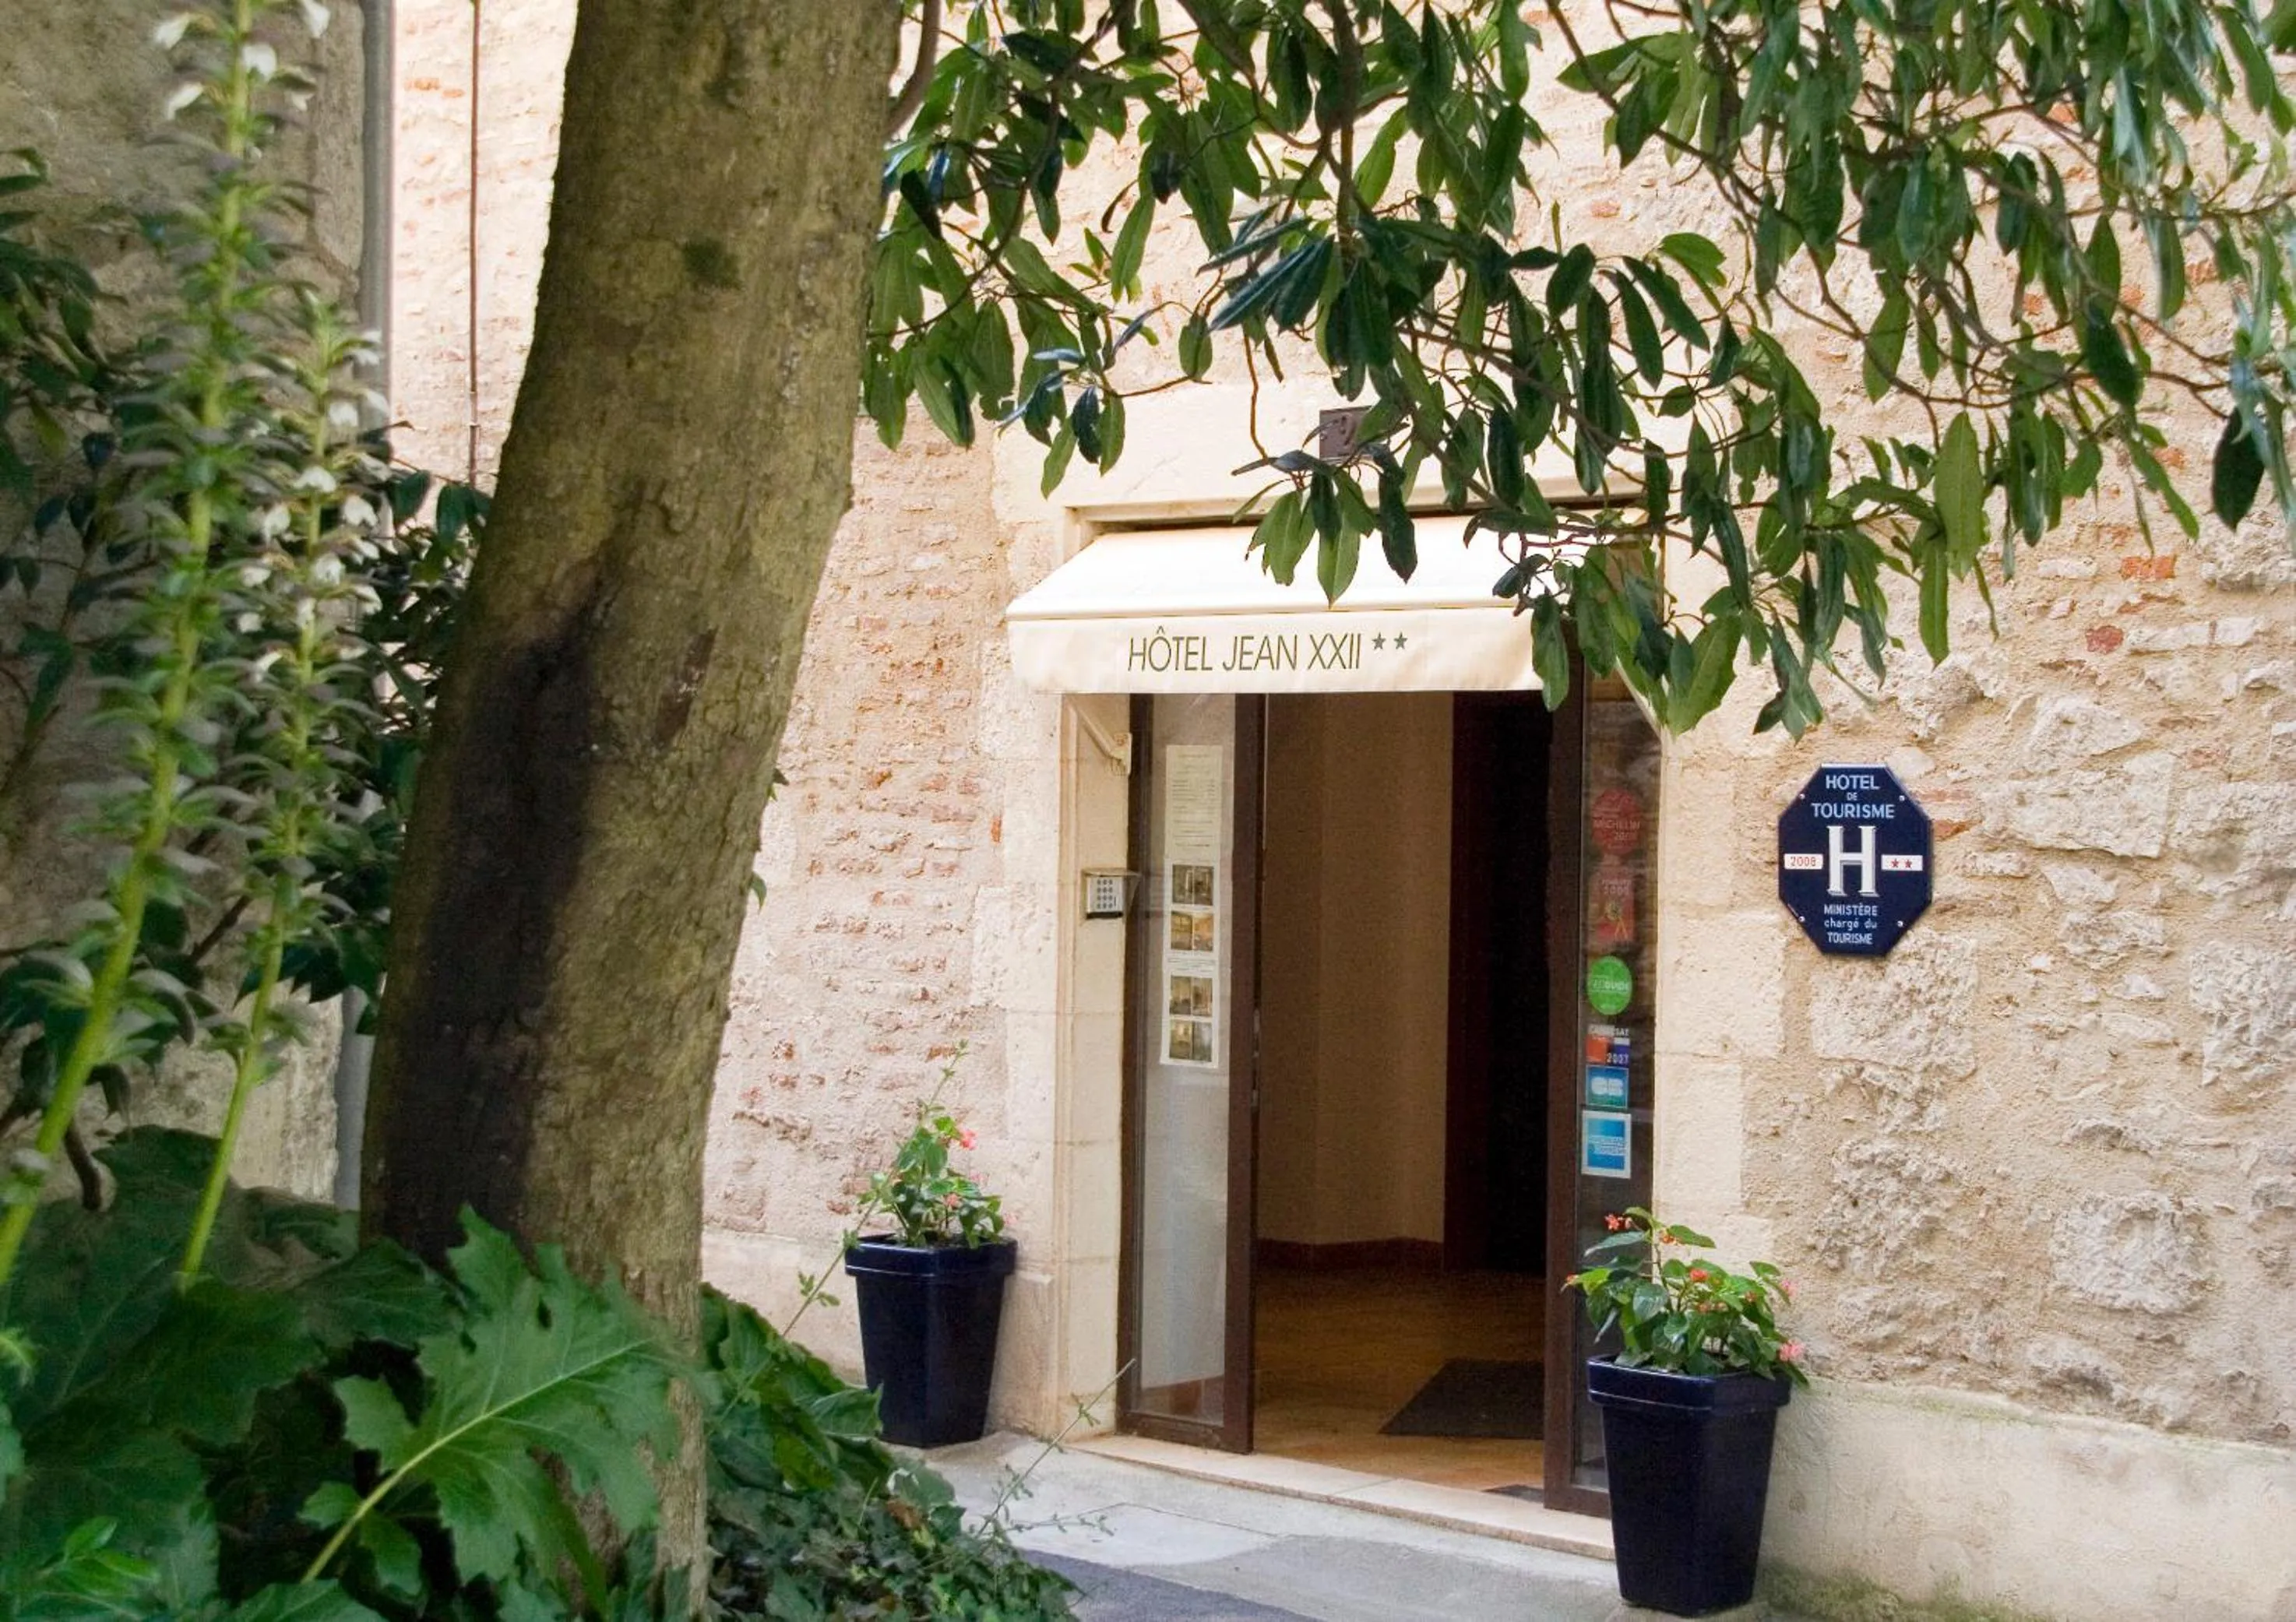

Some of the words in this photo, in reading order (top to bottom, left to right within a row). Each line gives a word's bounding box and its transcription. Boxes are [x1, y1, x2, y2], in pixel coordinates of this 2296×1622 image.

[1128, 625, 1213, 672] HÔTEL
[1222, 634, 1298, 672] JEAN
[1307, 632, 1363, 671] XXII
[1826, 775, 1880, 790] HOTEL
[1847, 791, 1858, 800] DE
[1812, 803, 1896, 818] TOURISME
[1826, 825, 1879, 897] H
[1823, 903, 1879, 917] MINISTÈRE
[1826, 932, 1873, 945] TOURISME
